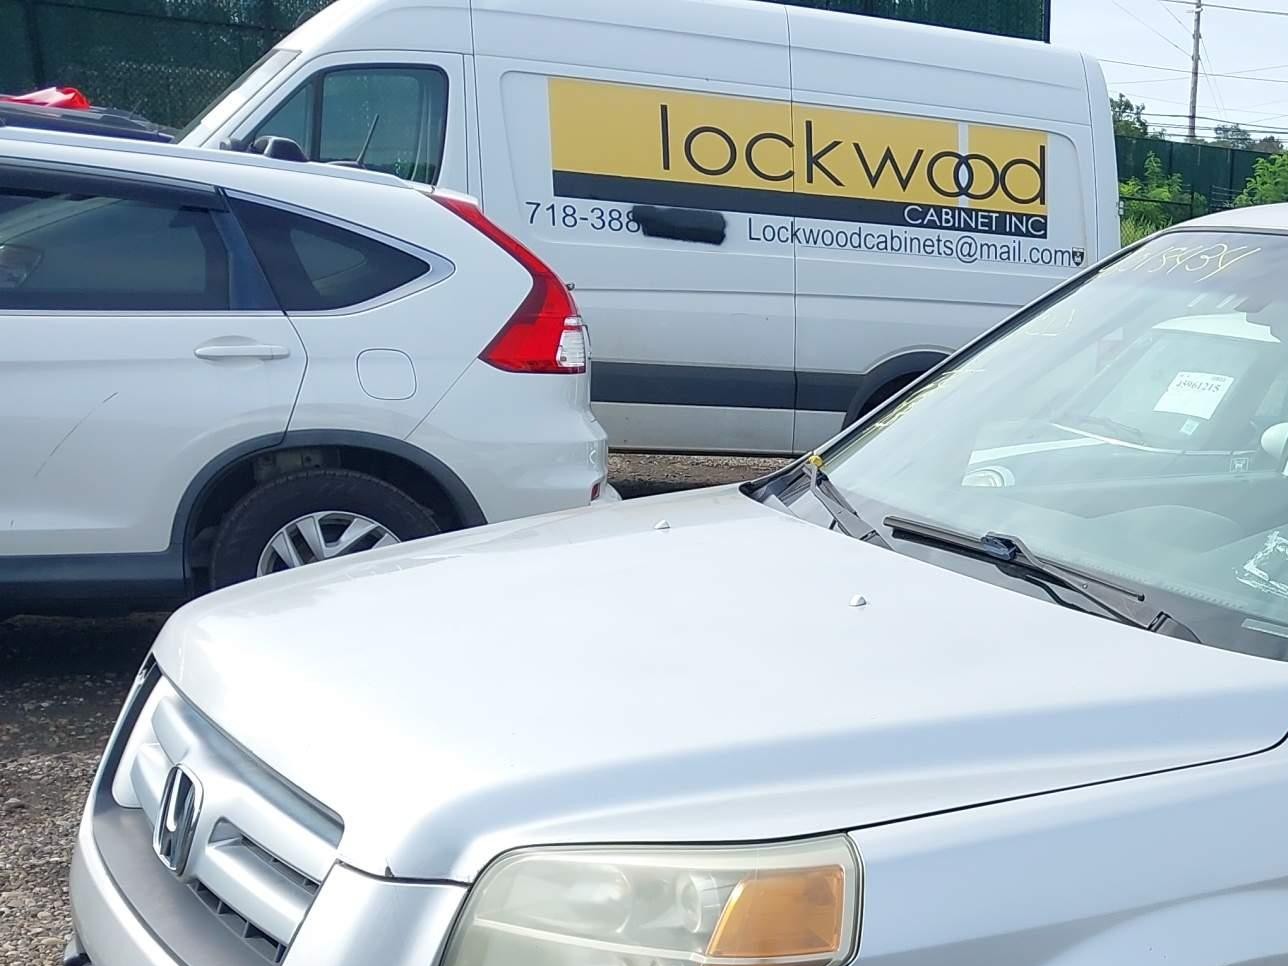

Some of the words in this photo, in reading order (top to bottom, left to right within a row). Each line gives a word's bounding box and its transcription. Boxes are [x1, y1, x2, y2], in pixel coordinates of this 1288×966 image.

[660, 104, 1047, 205] lockwood
[748, 216, 1072, 266] Lockwoodcabinets@mail.com
[903, 205, 1000, 231] CABINET
[1005, 215, 1046, 236] INC
